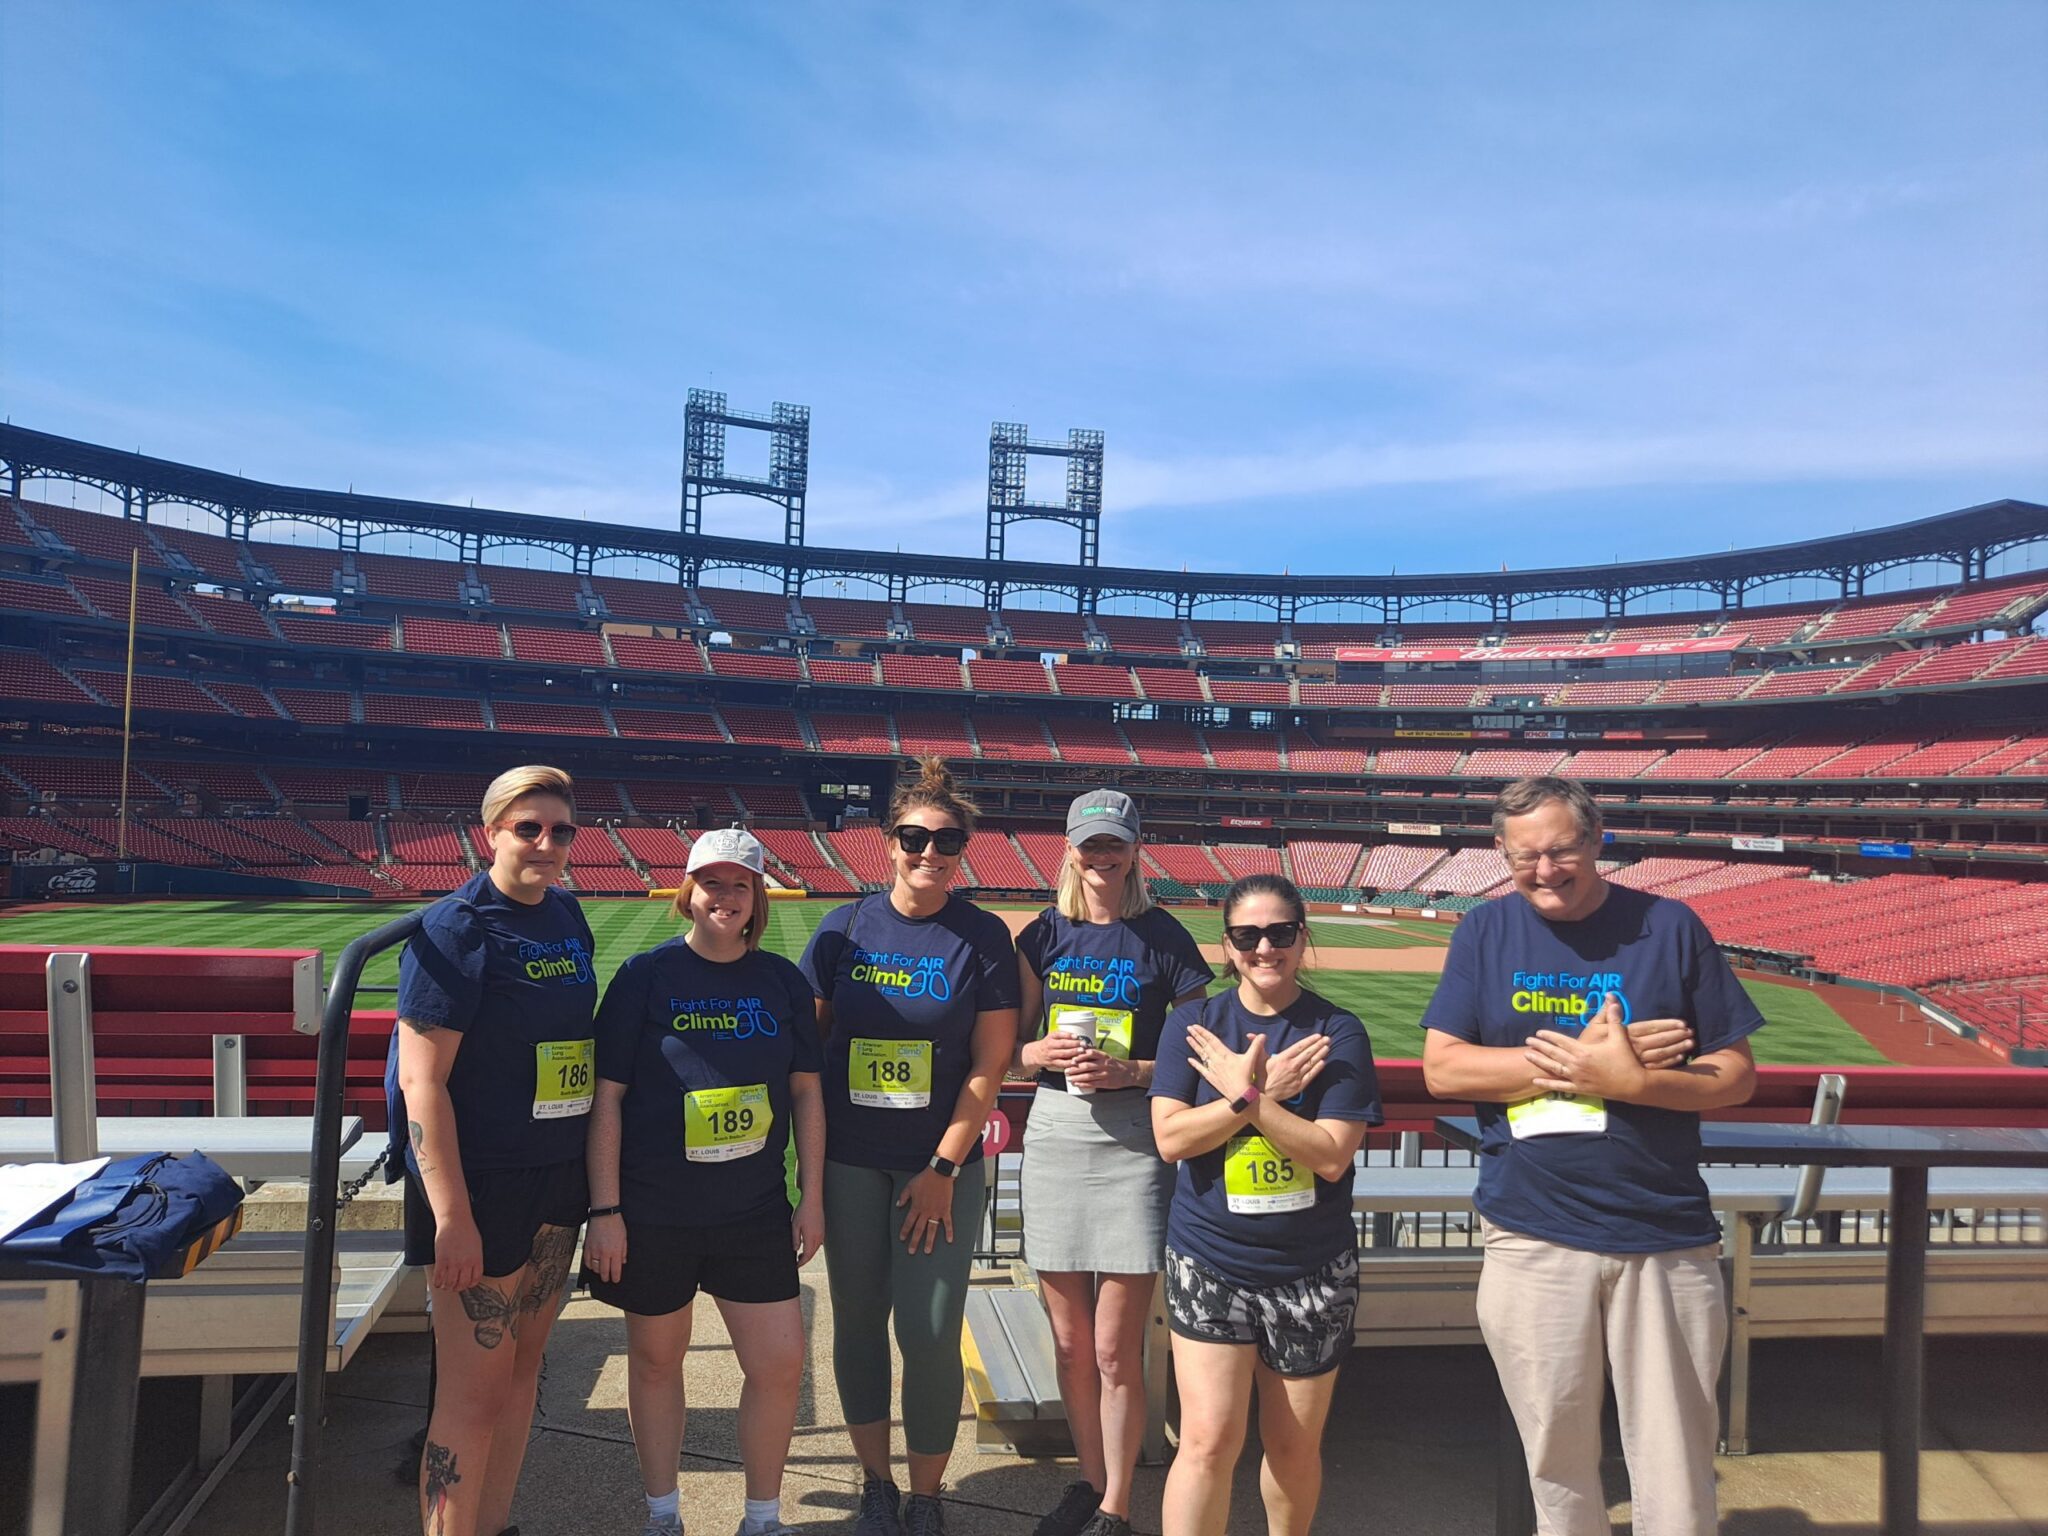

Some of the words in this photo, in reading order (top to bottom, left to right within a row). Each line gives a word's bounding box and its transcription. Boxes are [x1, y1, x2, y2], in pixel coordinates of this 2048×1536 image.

[1459, 645, 1616, 660] Budweiser
[526, 957, 576, 980] Climb
[854, 949, 889, 965] Fight
[892, 954, 914, 966] For
[917, 956, 945, 970] AIR
[1083, 956, 1105, 969] For
[1108, 958, 1134, 973] AIR
[851, 965, 912, 987] Climb
[1049, 971, 1105, 993] Climb
[1513, 971, 1555, 990] Fight
[1560, 973, 1586, 988] For
[1588, 972, 1622, 988] AIR
[670, 998, 708, 1012] Fight
[710, 999, 732, 1010] For
[737, 998, 762, 1011] AIR
[1512, 991, 1587, 1014] Climb
[673, 1013, 738, 1031] Climb
[897, 1048, 922, 1056] Climb
[558, 1063, 588, 1088] 186
[867, 1060, 911, 1083] 188
[708, 1108, 754, 1135] 189
[1246, 1158, 1294, 1184] 185
